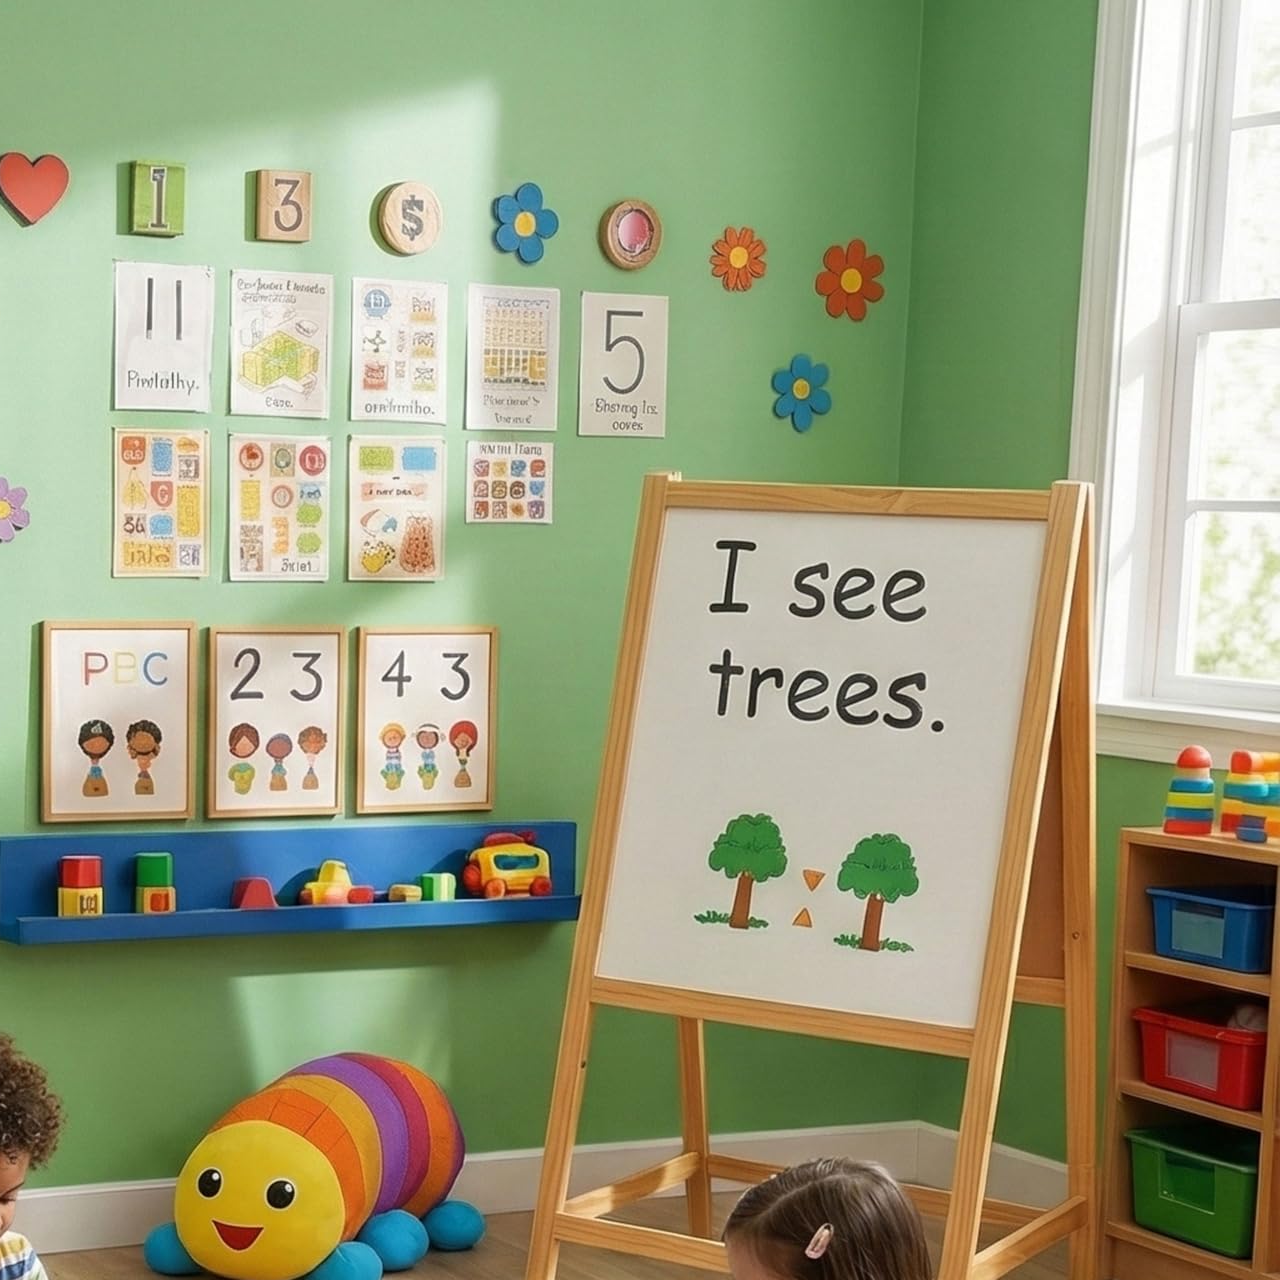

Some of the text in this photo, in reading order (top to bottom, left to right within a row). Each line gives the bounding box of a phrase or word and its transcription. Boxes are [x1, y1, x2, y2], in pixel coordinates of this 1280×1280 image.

[151, 167, 168, 228] 1
[274, 178, 303, 231] 3
[602, 309, 645, 394] 5
[709, 540, 927, 622] I see
[230, 647, 322, 701] 2 3
[381, 650, 471, 701] 4 3
[709, 649, 945, 733] trees.
